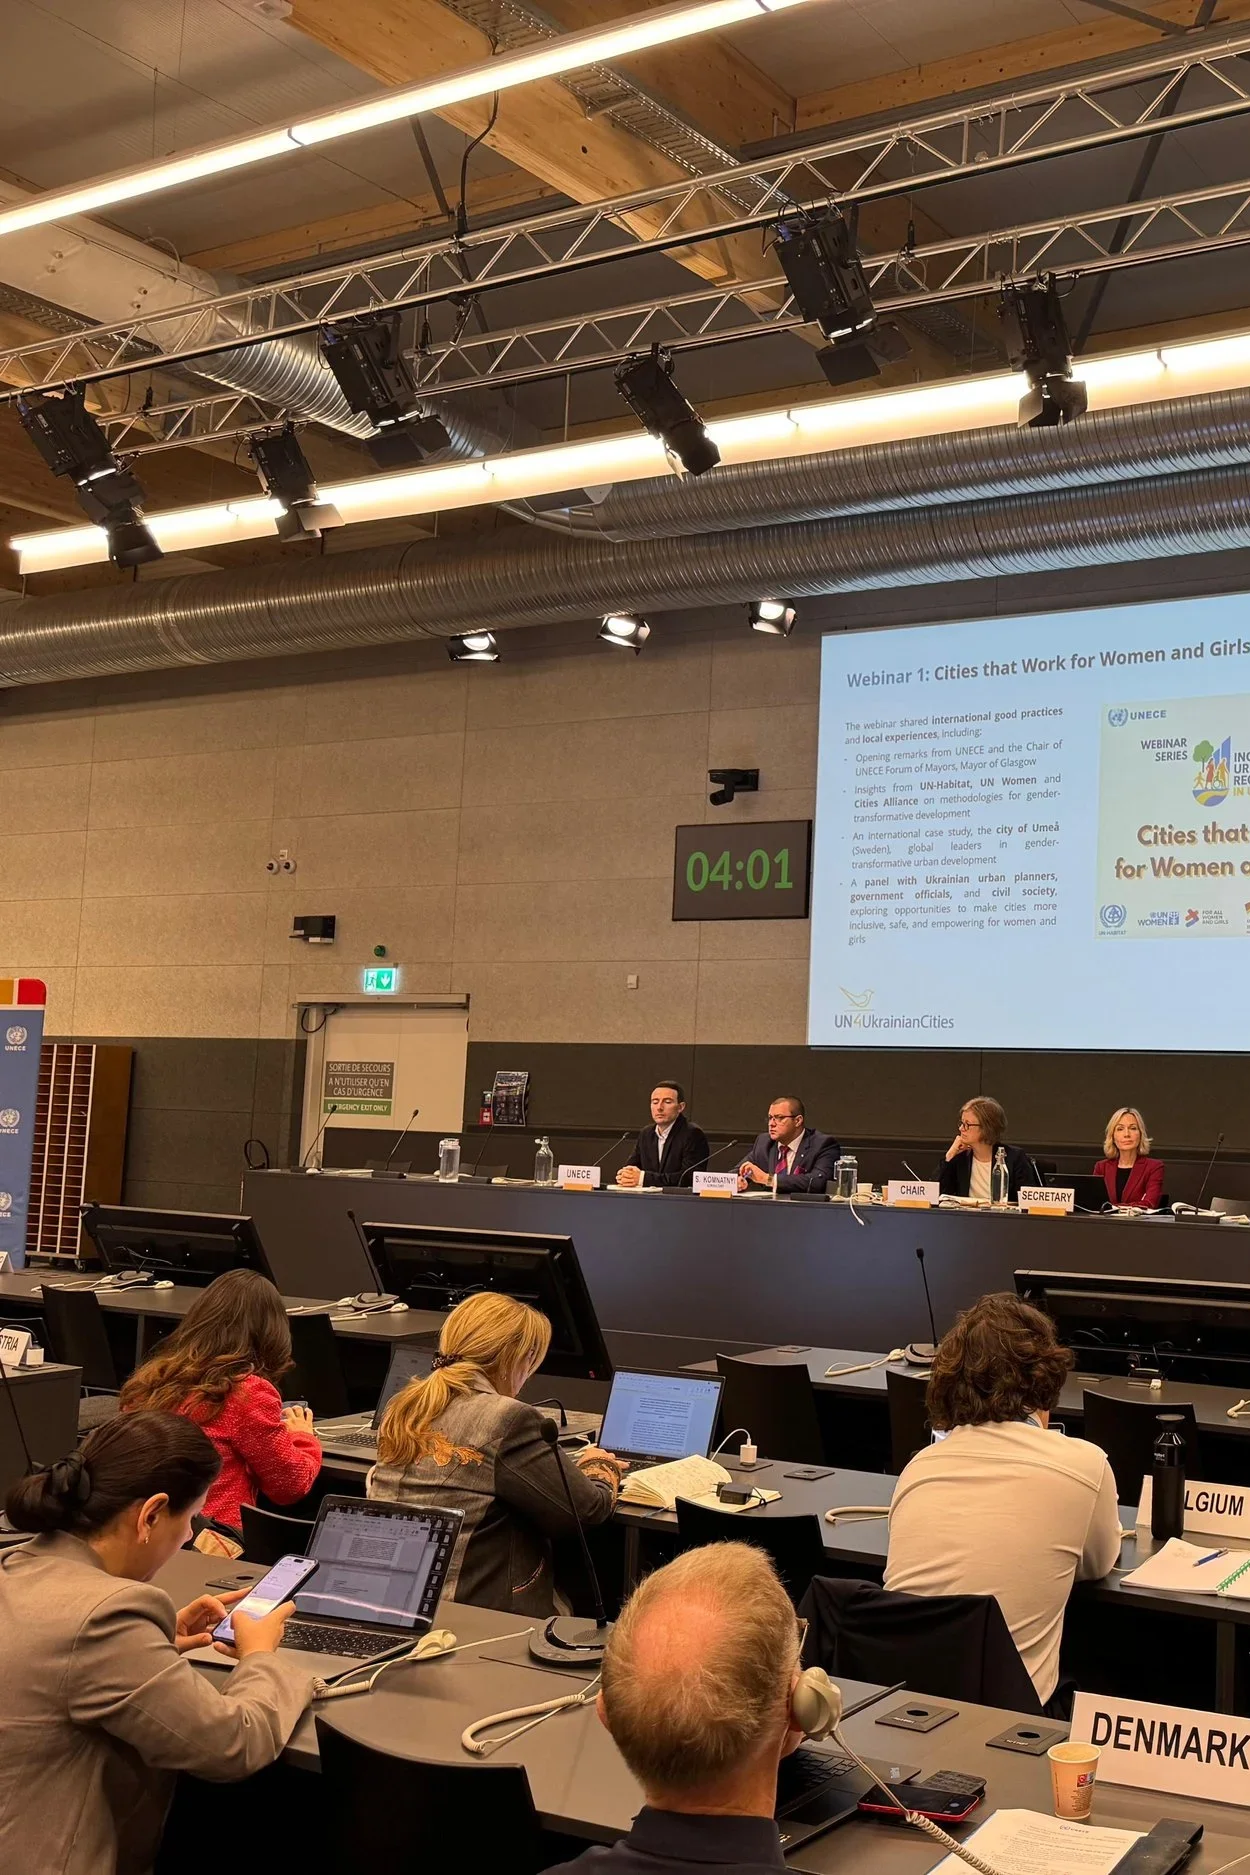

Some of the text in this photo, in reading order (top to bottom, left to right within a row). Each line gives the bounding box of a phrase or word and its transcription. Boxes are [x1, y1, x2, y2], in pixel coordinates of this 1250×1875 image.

[847, 639, 1250, 688] Webinar 1: Cities that Work for Women and Girls
[845, 707, 1063, 731] The webinar shared international good practices
[1130, 710, 1166, 720] UNECE
[845, 736, 860, 744] and
[862, 735, 882, 743] local
[885, 731, 939, 743] experiences,
[1141, 738, 1187, 750] WEBINAR
[856, 740, 1062, 764] Opening remarks from UNECE and the Chair of
[1155, 750, 1187, 762] SERIES
[856, 757, 1036, 776] UNECE Forum of Mayors, Mayor of Glasgow
[855, 774, 1061, 795] Insights from UN-Habitat, UN Women and
[1233, 786, 1244, 796] IN
[855, 789, 1060, 808] Cities Alliance on methodologies for gender-
[854, 809, 970, 823] transformative development
[853, 831, 863, 840] An
[868, 829, 920, 840] international
[925, 829, 943, 837] case
[948, 826, 973, 837] study,
[978, 826, 992, 835] the
[996, 824, 1013, 836] city
[1018, 824, 1027, 833] of
[1137, 824, 1198, 846] Cities
[1203, 821, 1249, 844] that
[908, 843, 934, 855] global
[951, 841, 982, 851] leaders
[1000, 840, 1007, 848] in
[1025, 838, 1059, 849] gender-
[686, 848, 793, 892] 04:01
[852, 856, 996, 869] transformative urban development
[1115, 857, 1148, 880] for
[1150, 856, 1234, 878] Women
[851, 872, 1058, 889] A panel with Ukrainian urban planners,
[850, 891, 903, 903] government
[915, 889, 952, 900] officials,
[964, 889, 980, 898] and
[992, 887, 1010, 897] civil
[850, 905, 888, 917] exploring
[894, 905, 950, 916] opportunities
[974, 903, 997, 912] make
[1004, 902, 1026, 912] cities
[1034, 903, 1057, 911] more
[850, 916, 1056, 931] inclusive, safe, and empowering for women and
[849, 934, 866, 945] girls
[834, 1014, 954, 1028] UN4UkrainianCities
[362, 1064, 390, 1072] SECOURS
[567, 1169, 591, 1179] UNECE
[901, 1185, 925, 1195] CHAIR
[1022, 1191, 1072, 1203] SECRETARY
[1184, 1490, 1244, 1516] LGIUM
